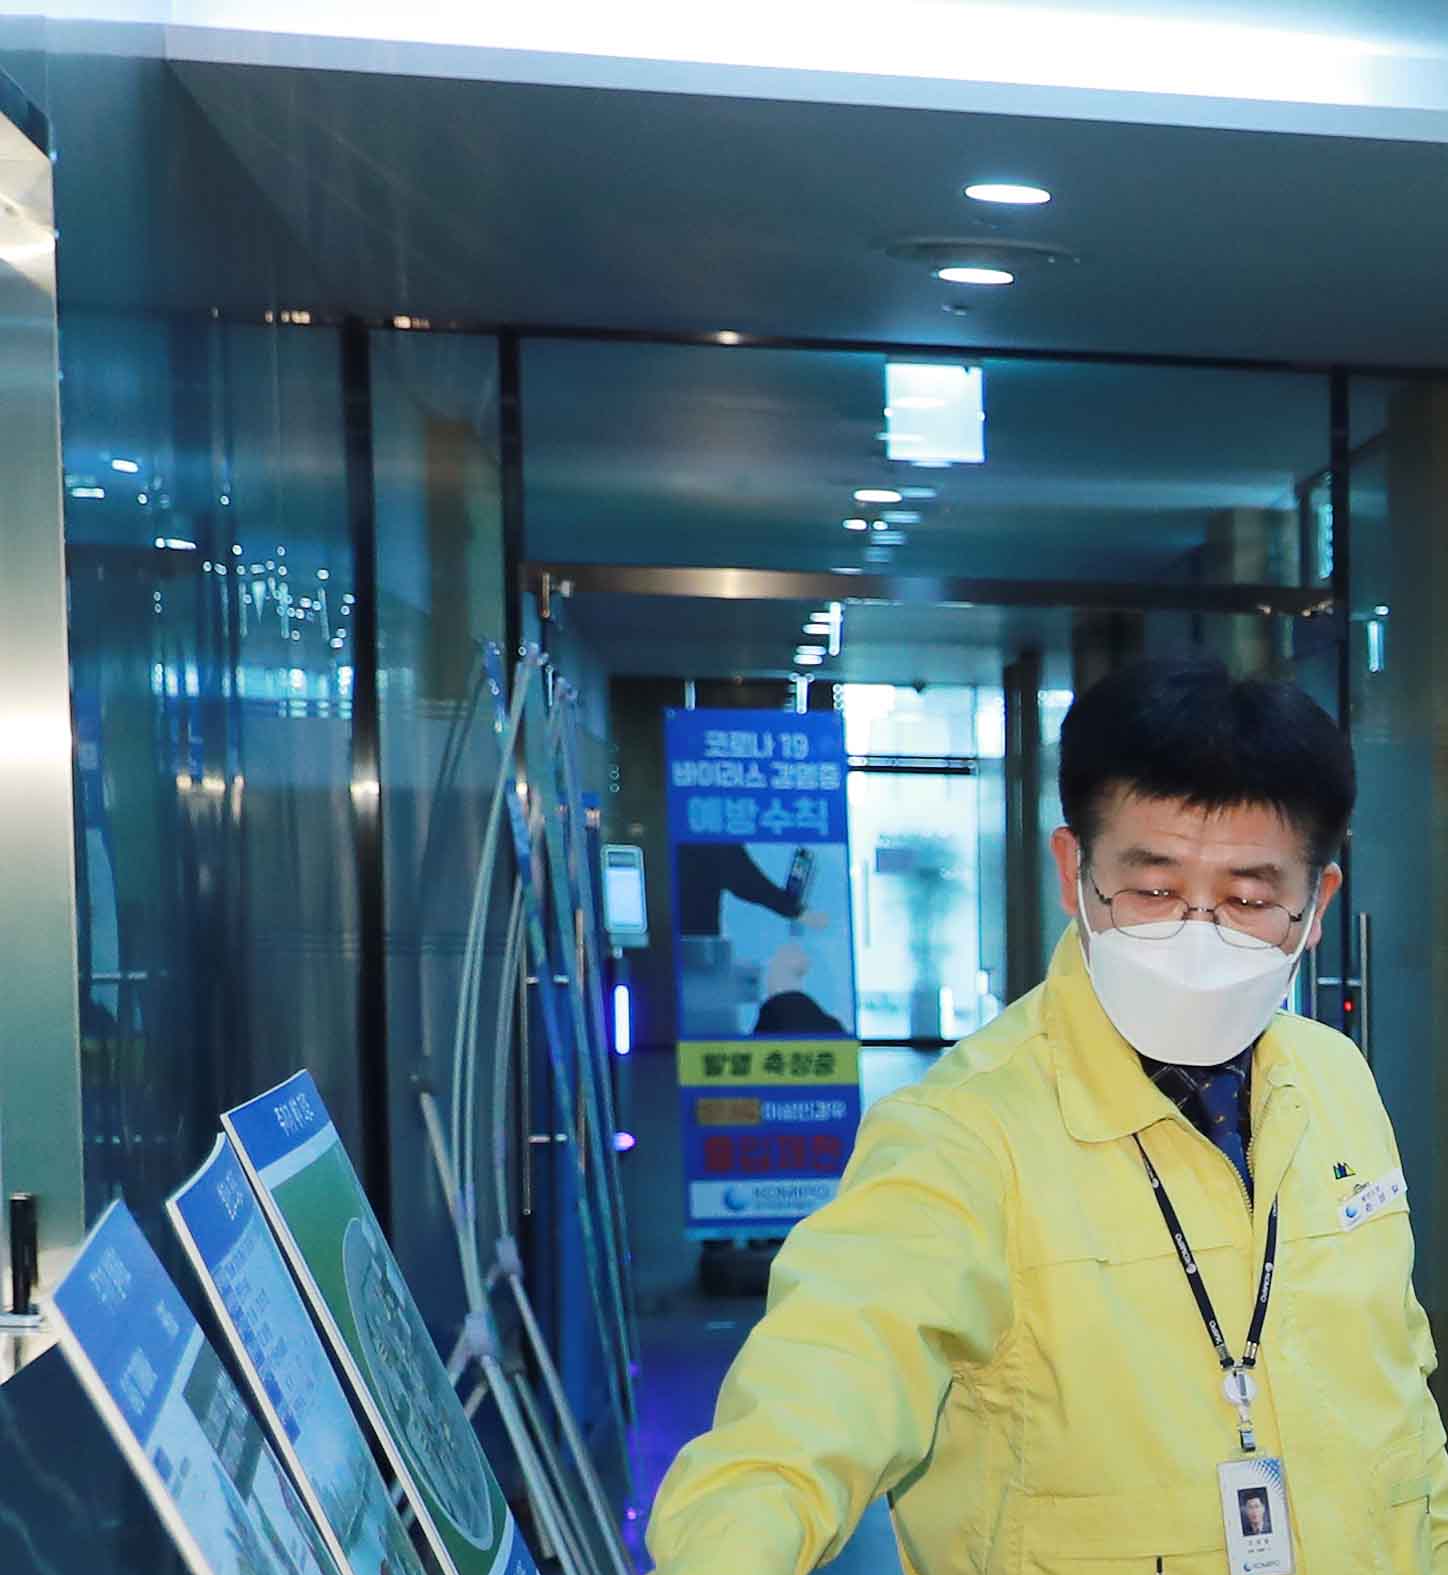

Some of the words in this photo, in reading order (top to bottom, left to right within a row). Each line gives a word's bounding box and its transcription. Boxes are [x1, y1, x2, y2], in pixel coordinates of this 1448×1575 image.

[704, 730, 774, 759] 코로나
[779, 732, 809, 760] 19
[672, 760, 768, 788] 바이러스
